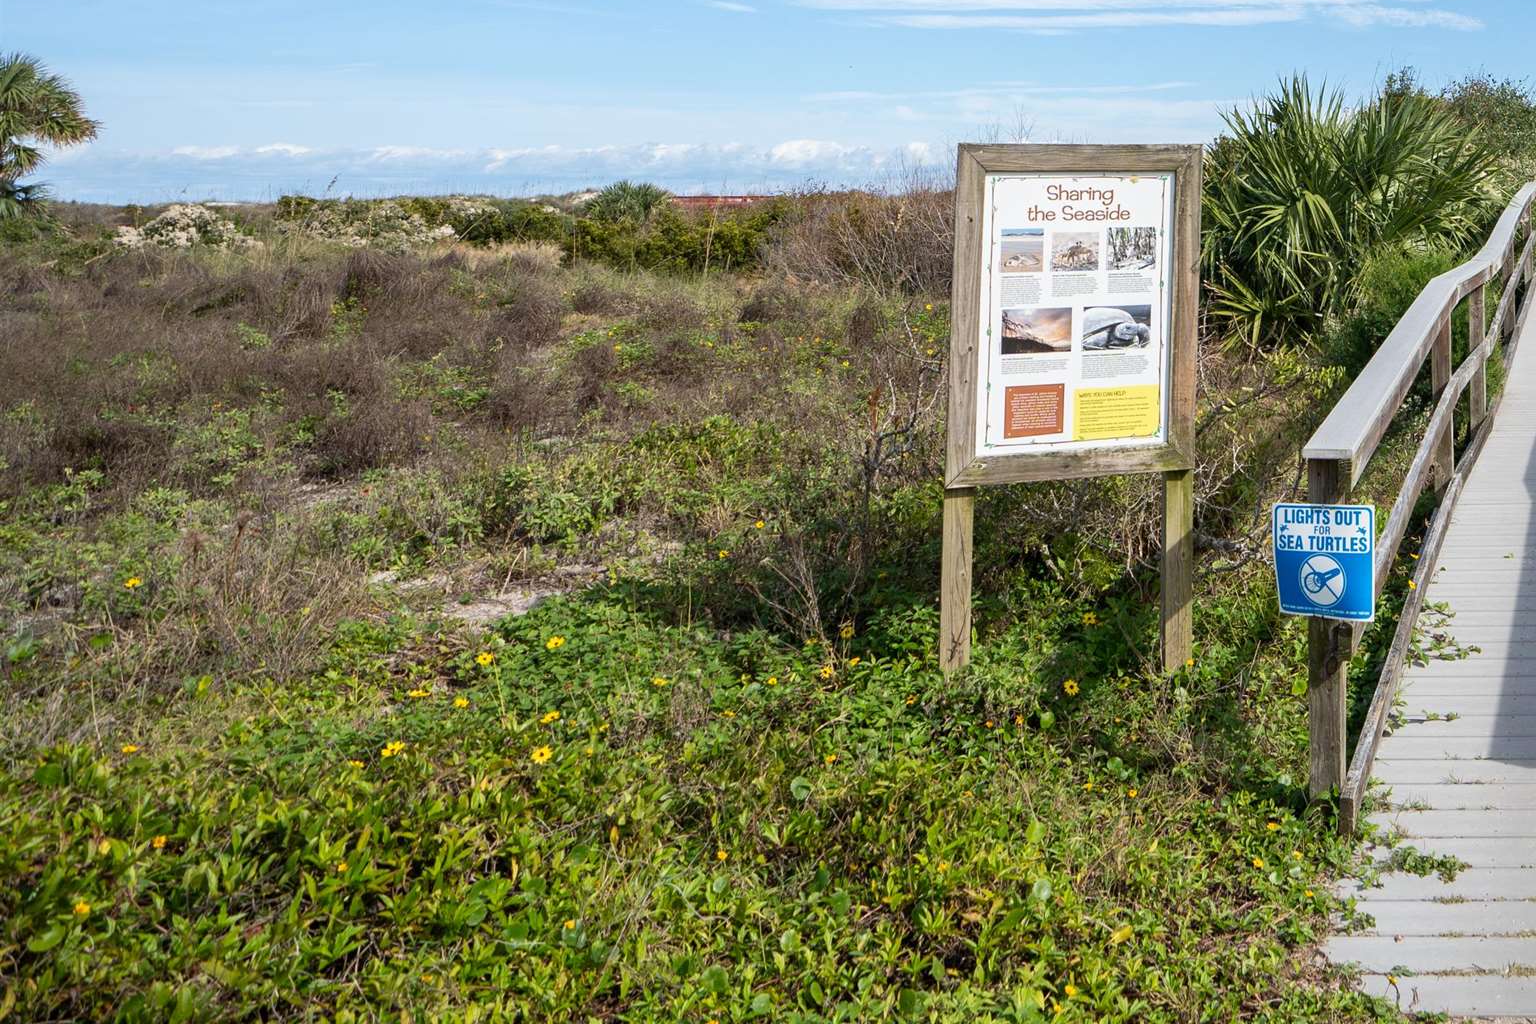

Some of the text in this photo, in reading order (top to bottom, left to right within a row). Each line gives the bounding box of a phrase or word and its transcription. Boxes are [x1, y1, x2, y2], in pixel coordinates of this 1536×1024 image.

[1046, 184, 1114, 206] Sharing
[1027, 203, 1131, 222] the Seaside
[1284, 509, 1362, 526] LIGHTS OUT
[1313, 525, 1331, 535] FOR
[1279, 534, 1367, 552] SEA TURTLES
